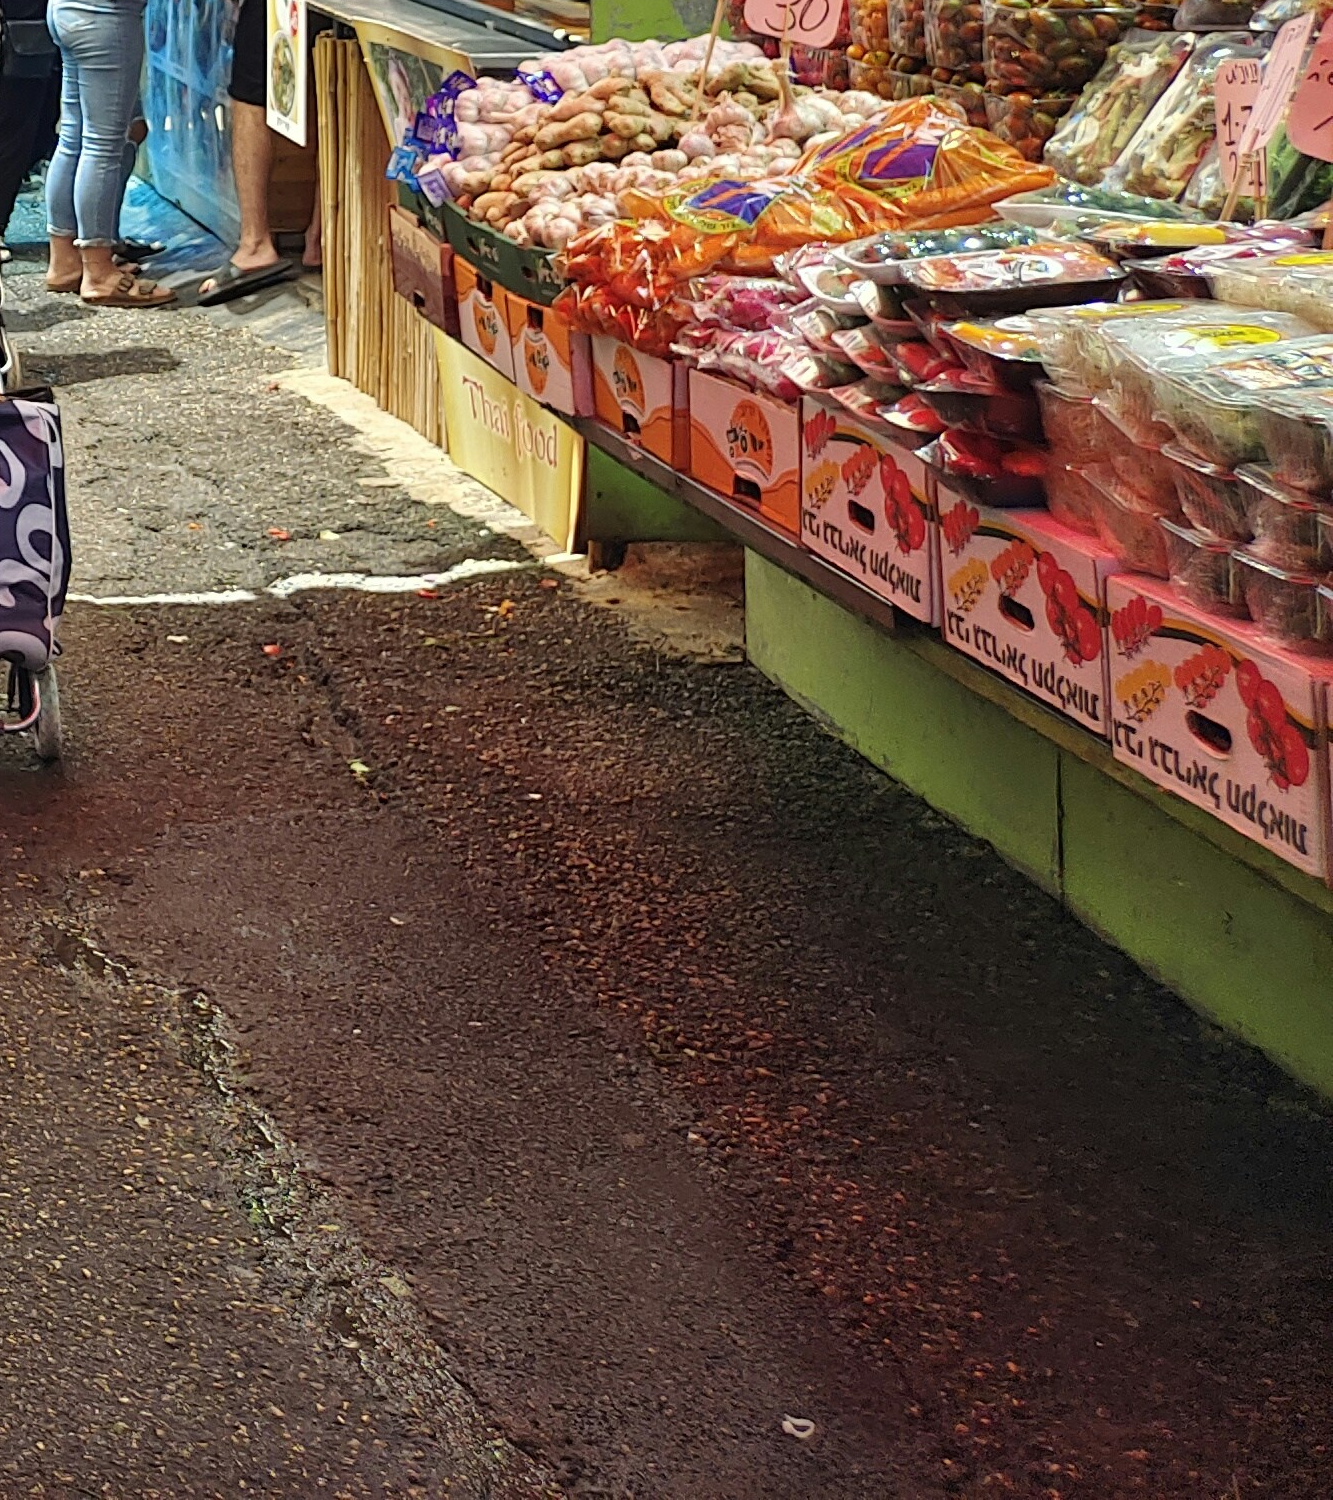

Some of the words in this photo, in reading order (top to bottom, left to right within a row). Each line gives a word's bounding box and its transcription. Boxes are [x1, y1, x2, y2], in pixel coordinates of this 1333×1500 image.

[462, 376, 510, 438] Thai
[513, 402, 558, 468] food
[823, 526, 867, 571] גבריאל
[869, 551, 921, 605] חקלאות
[973, 623, 1028, 681] גבריאל
[1031, 658, 1100, 722] חקלאות
[1149, 735, 1220, 801] גבריאל
[1226, 778, 1308, 857] חקלאות
